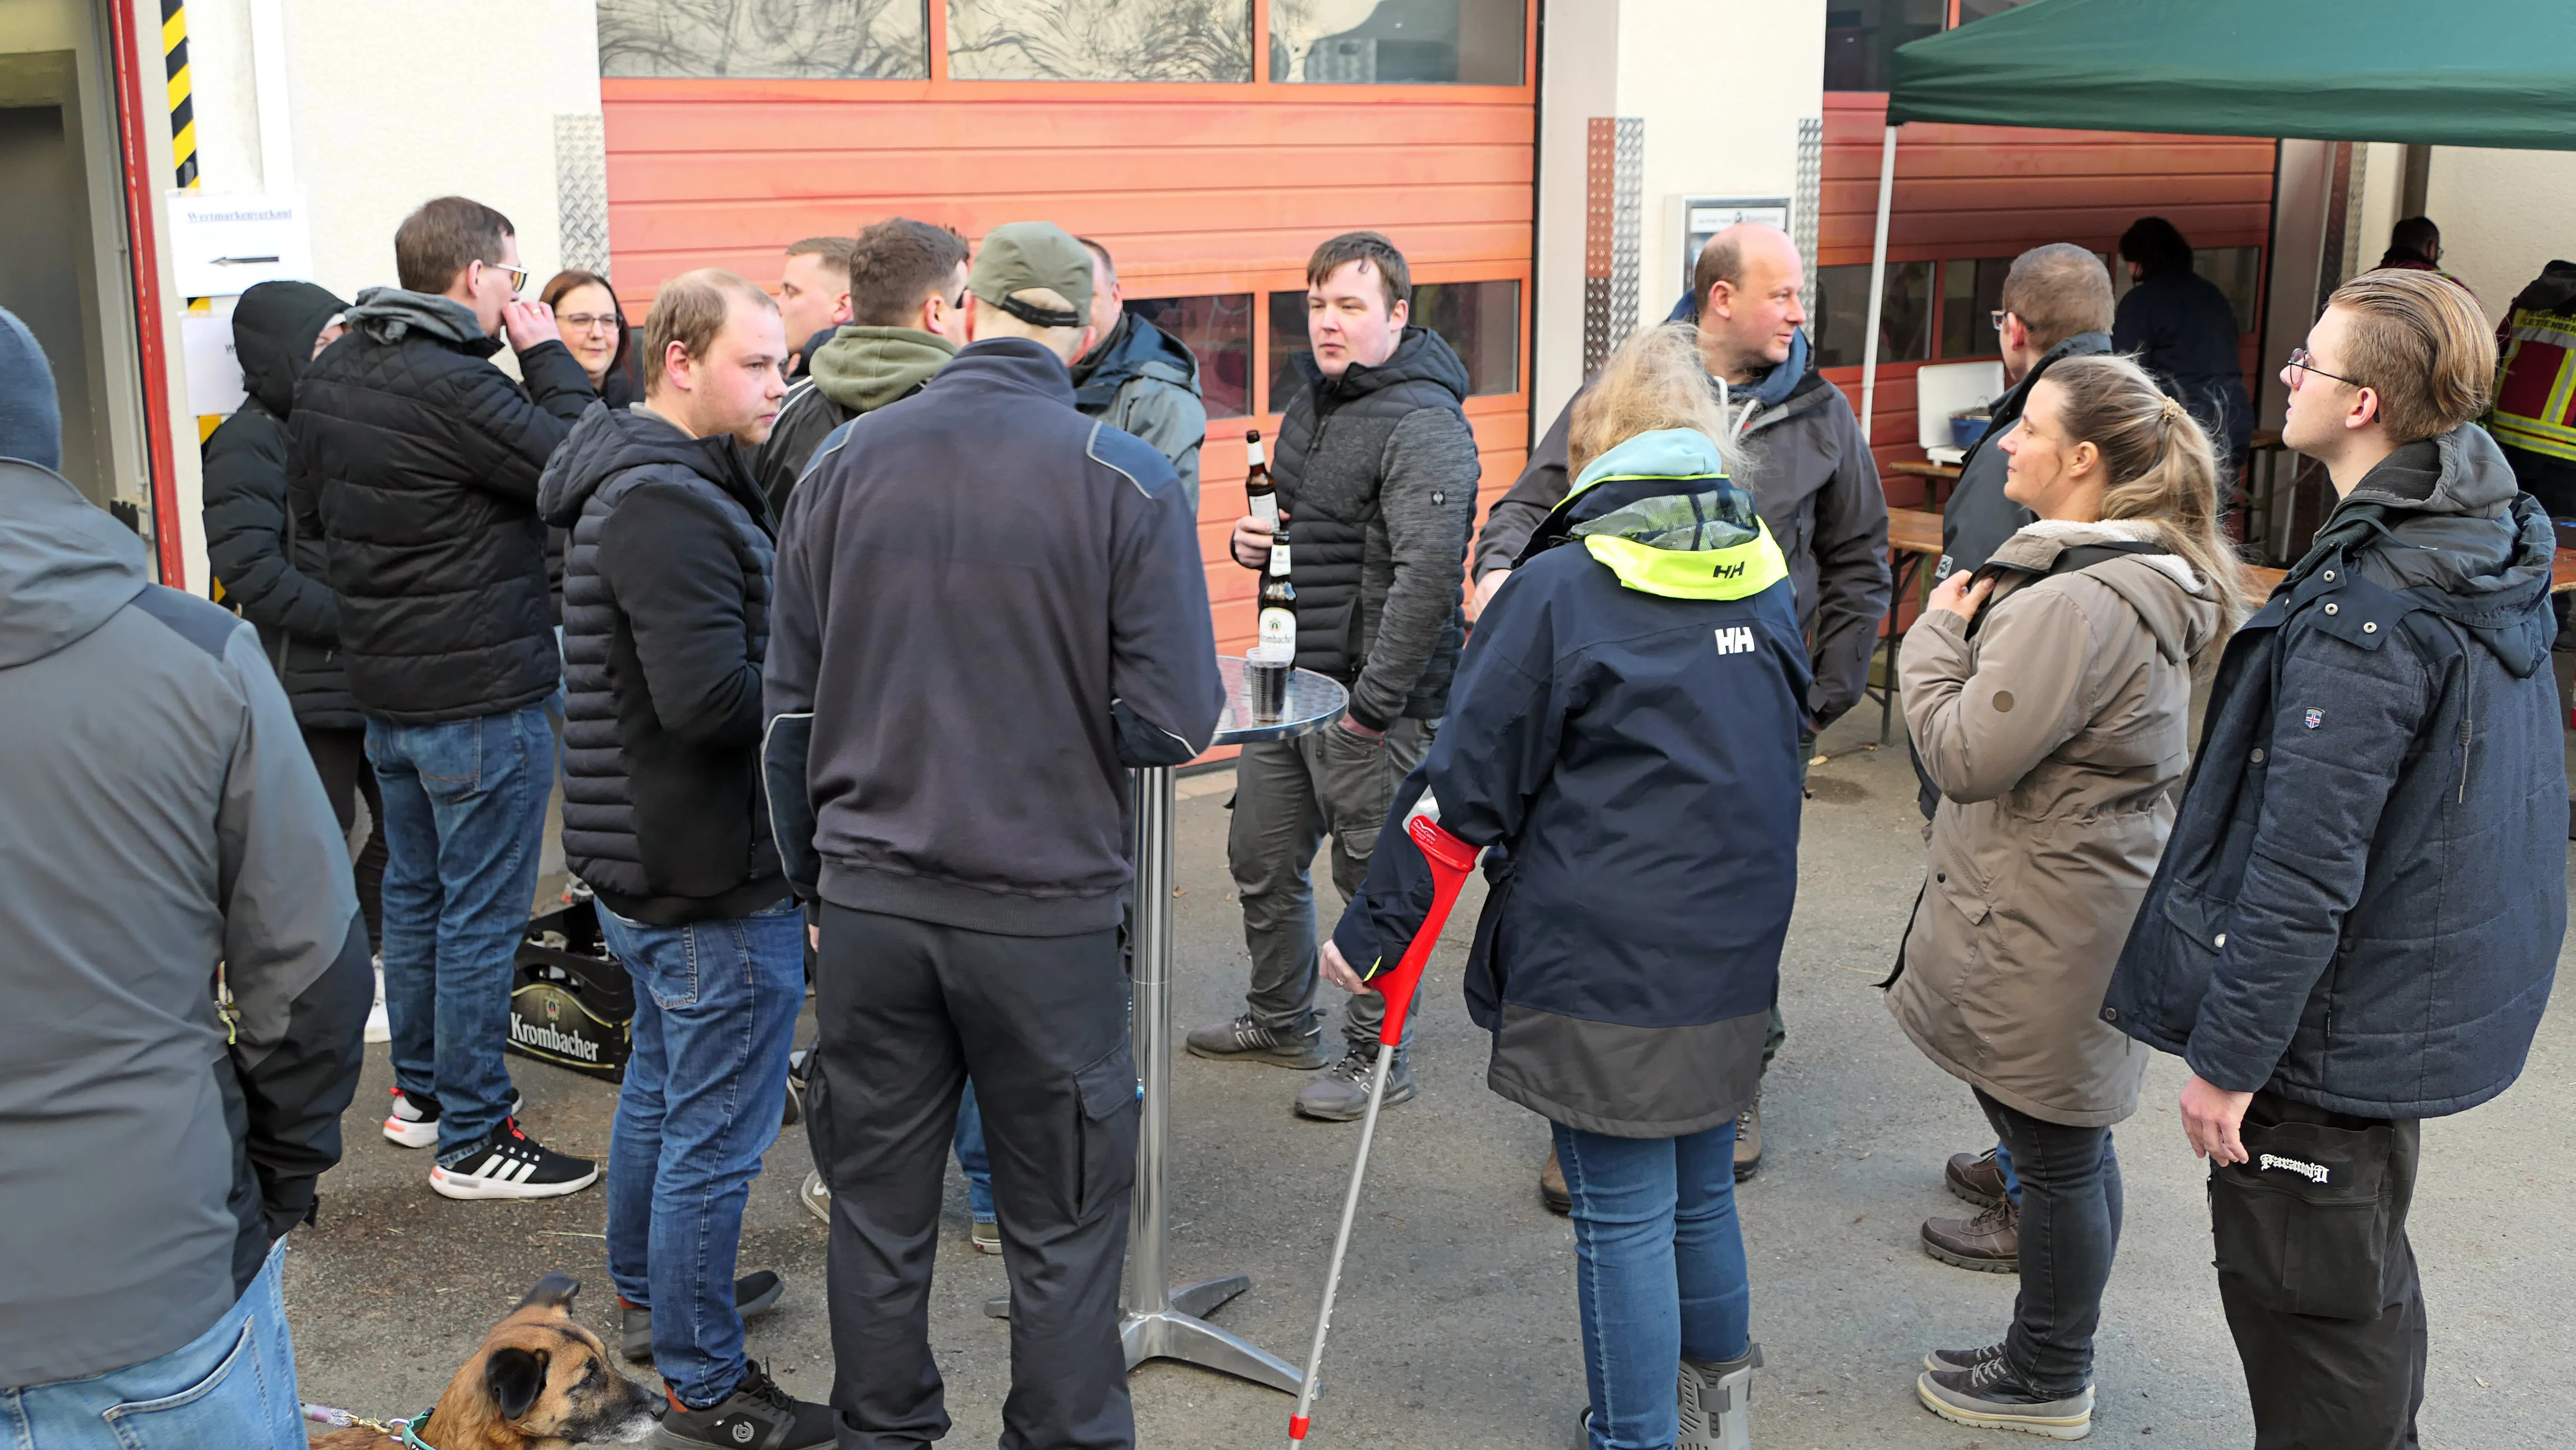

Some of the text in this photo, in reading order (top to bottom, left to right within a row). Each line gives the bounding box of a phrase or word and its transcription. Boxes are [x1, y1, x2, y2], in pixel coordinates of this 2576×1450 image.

[187, 209, 292, 223] Wertmarkenverkauf
[1713, 561, 1745, 579] HH
[1715, 626, 1755, 655] HH
[510, 1012, 599, 1061] Krombacher
